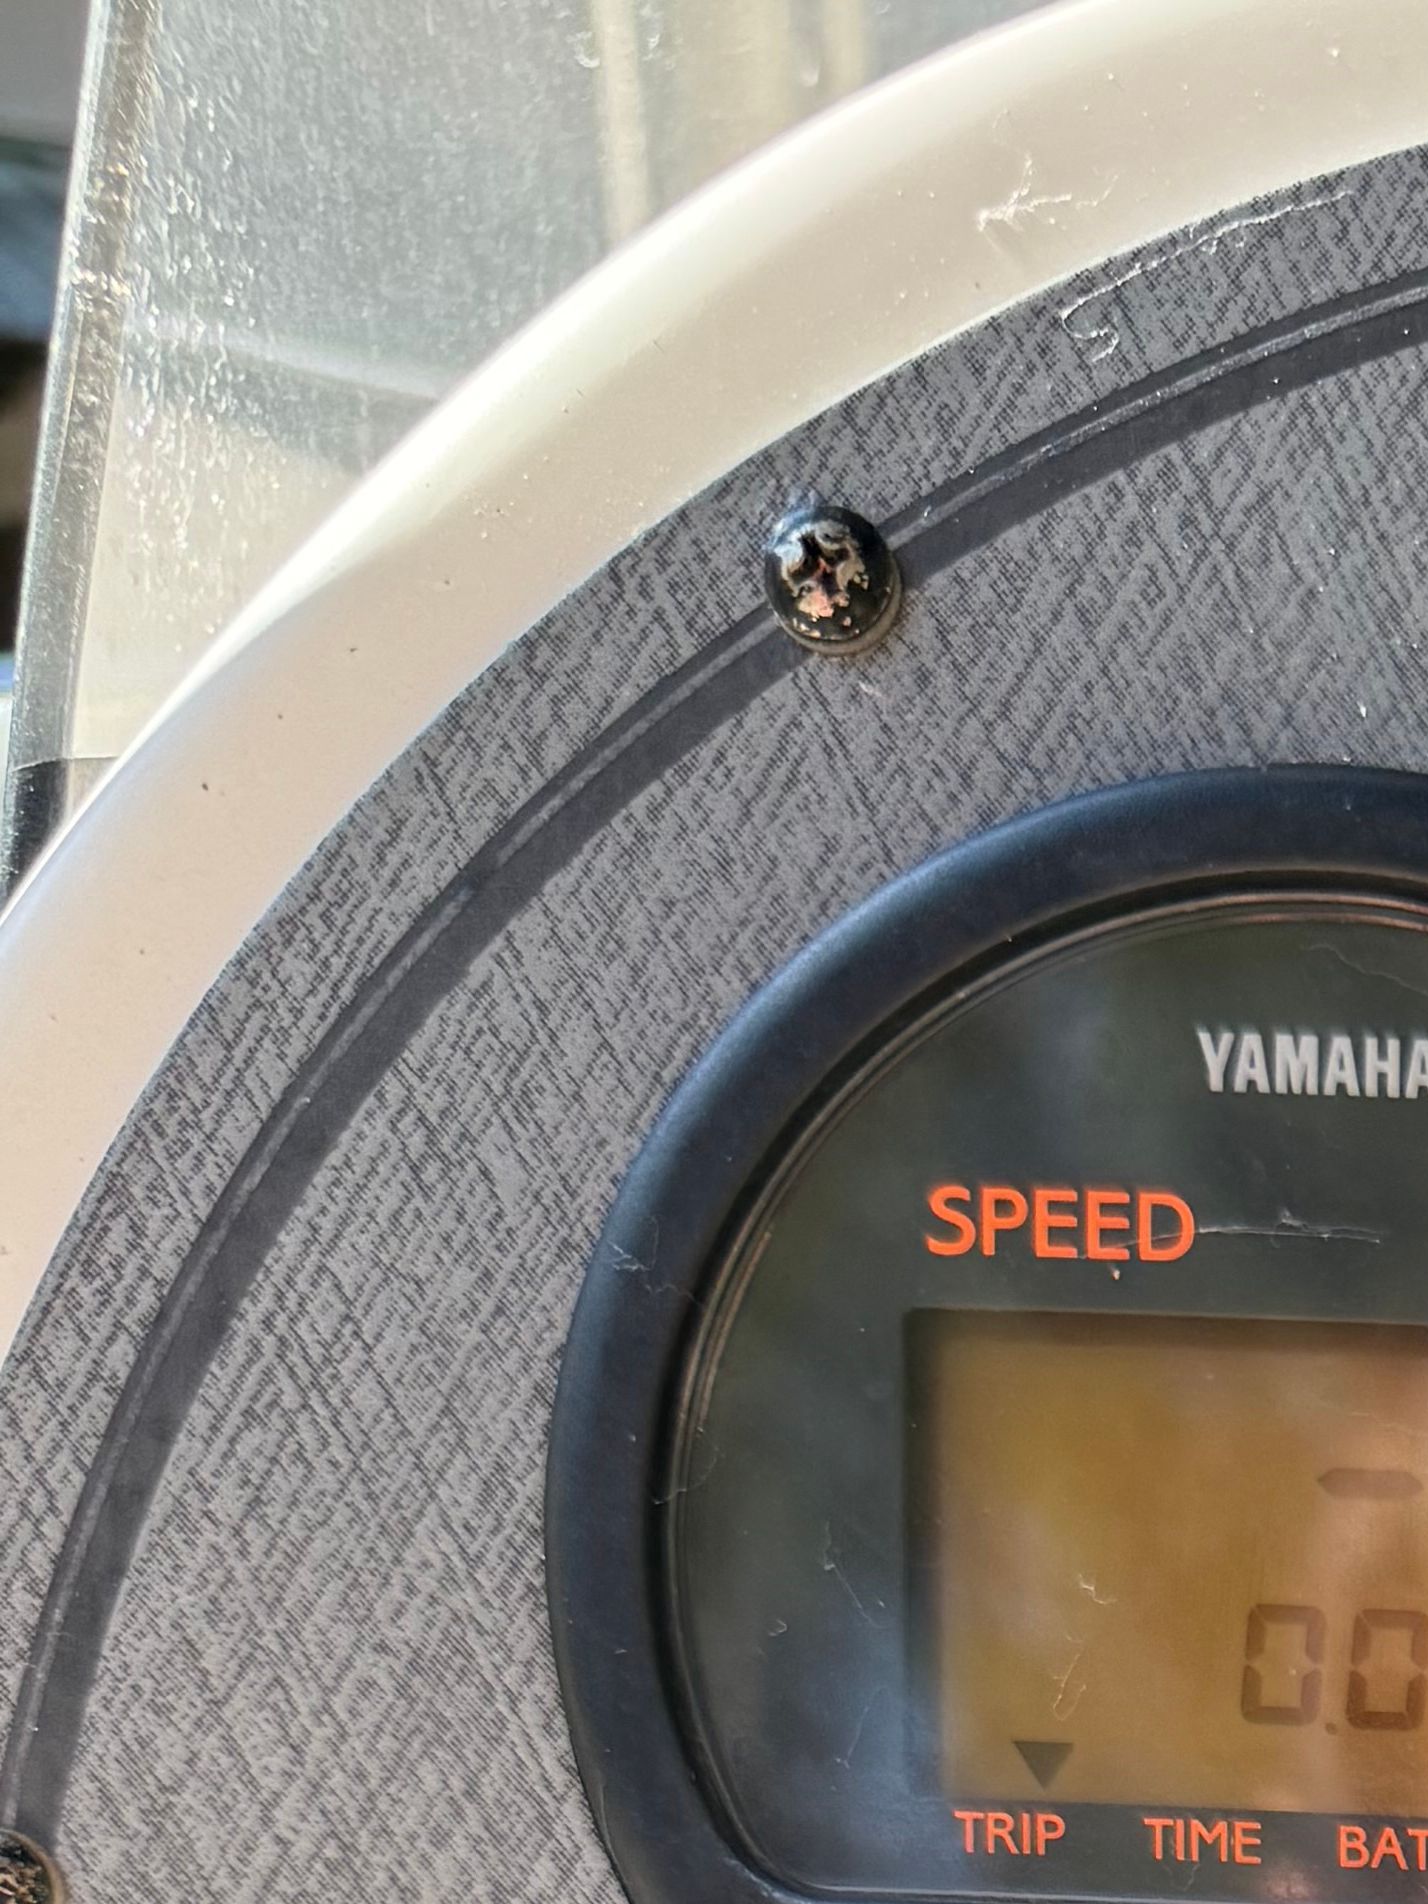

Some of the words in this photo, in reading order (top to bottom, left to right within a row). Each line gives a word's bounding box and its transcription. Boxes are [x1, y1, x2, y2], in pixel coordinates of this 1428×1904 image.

[924, 1185, 1196, 1263] SPEED
[956, 1809, 1066, 1856] TRIP
[1143, 1817, 1263, 1865] TIME
